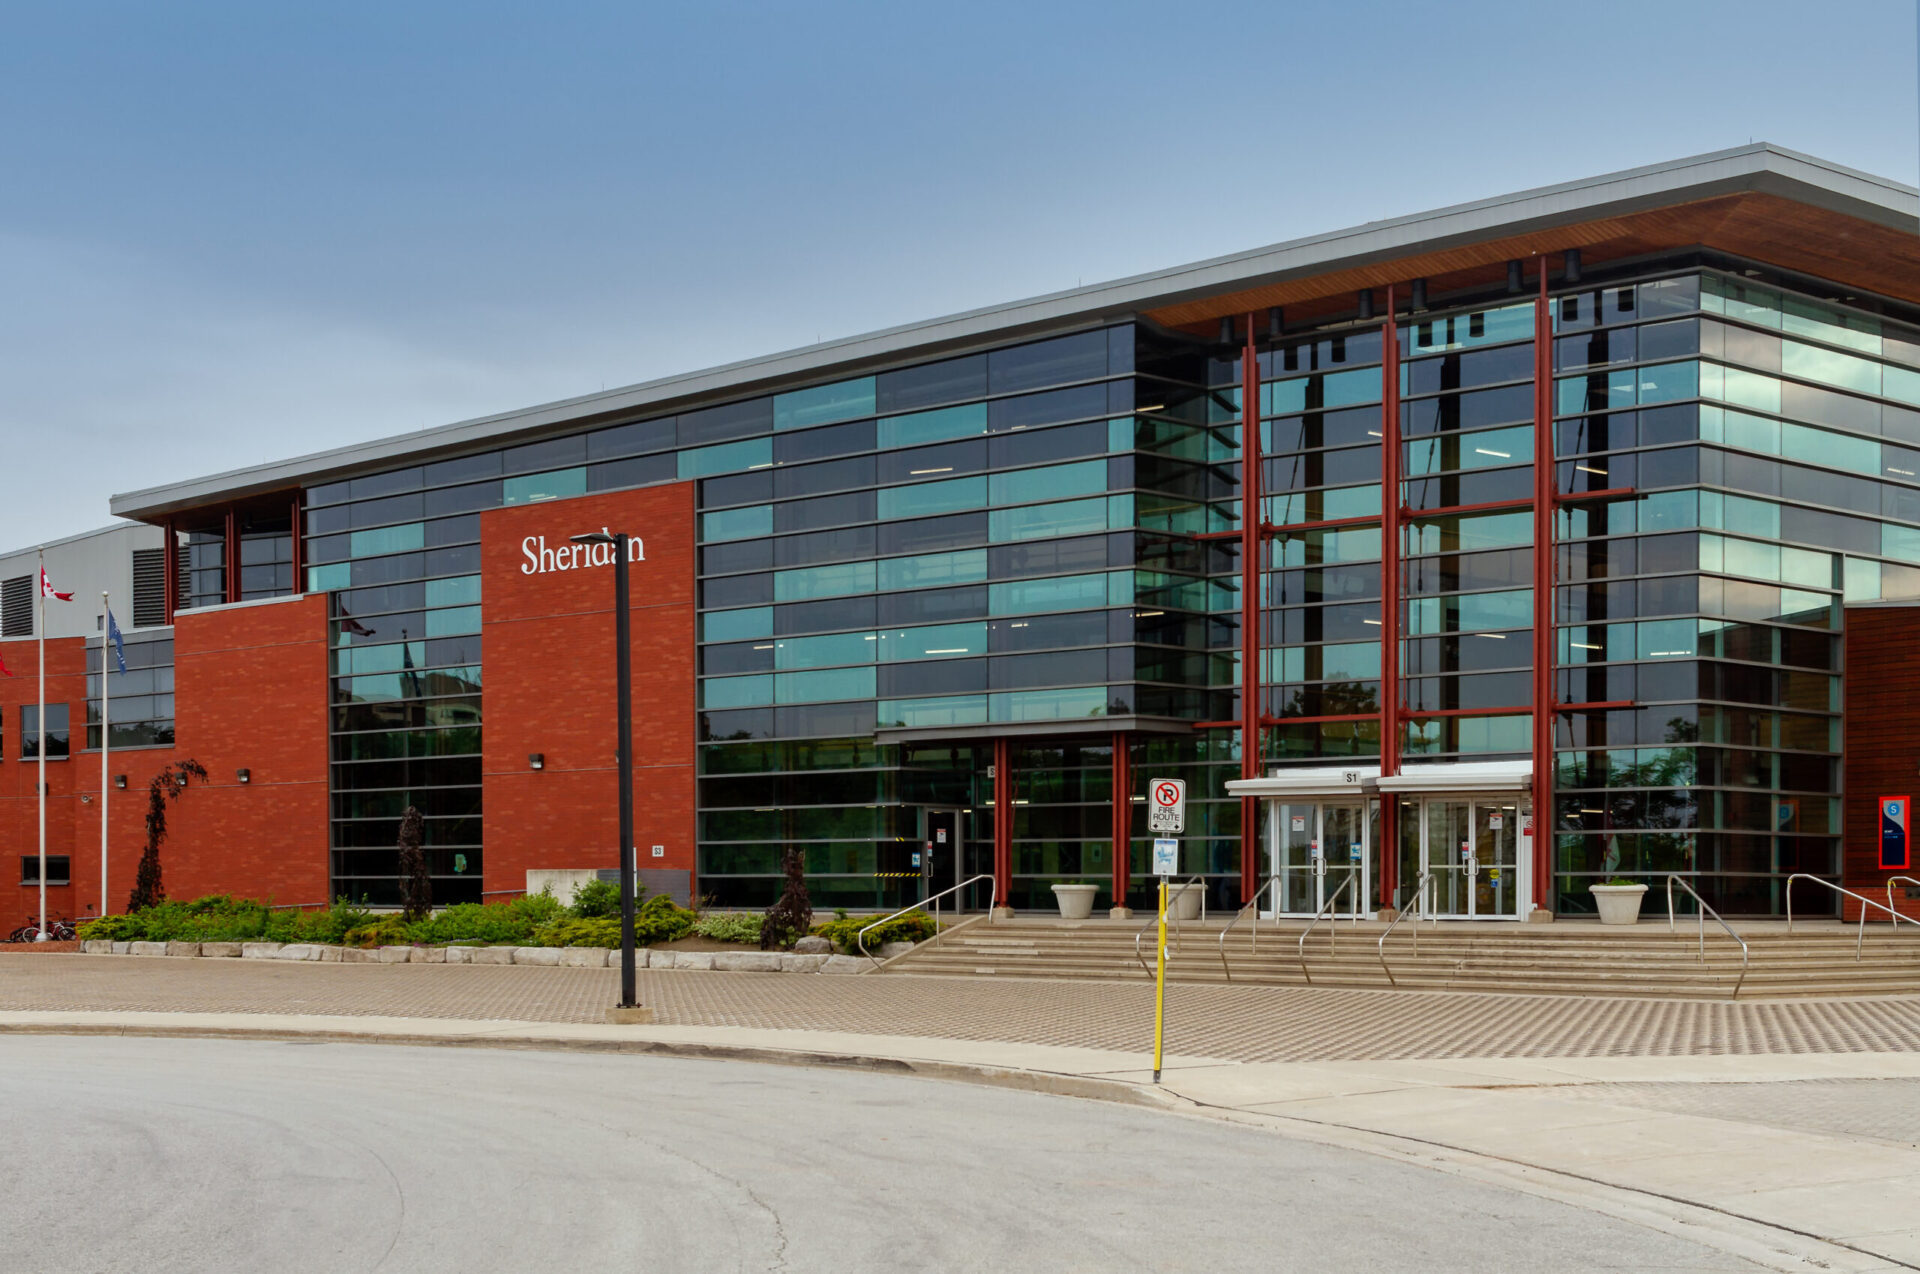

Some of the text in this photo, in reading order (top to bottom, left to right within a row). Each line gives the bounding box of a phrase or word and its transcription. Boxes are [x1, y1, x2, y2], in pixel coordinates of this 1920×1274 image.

[1346, 773, 1357, 783] S1
[1158, 806, 1175, 814] FIRE
[1153, 813, 1180, 822] ROUTE
[654, 847, 662, 855] S3
